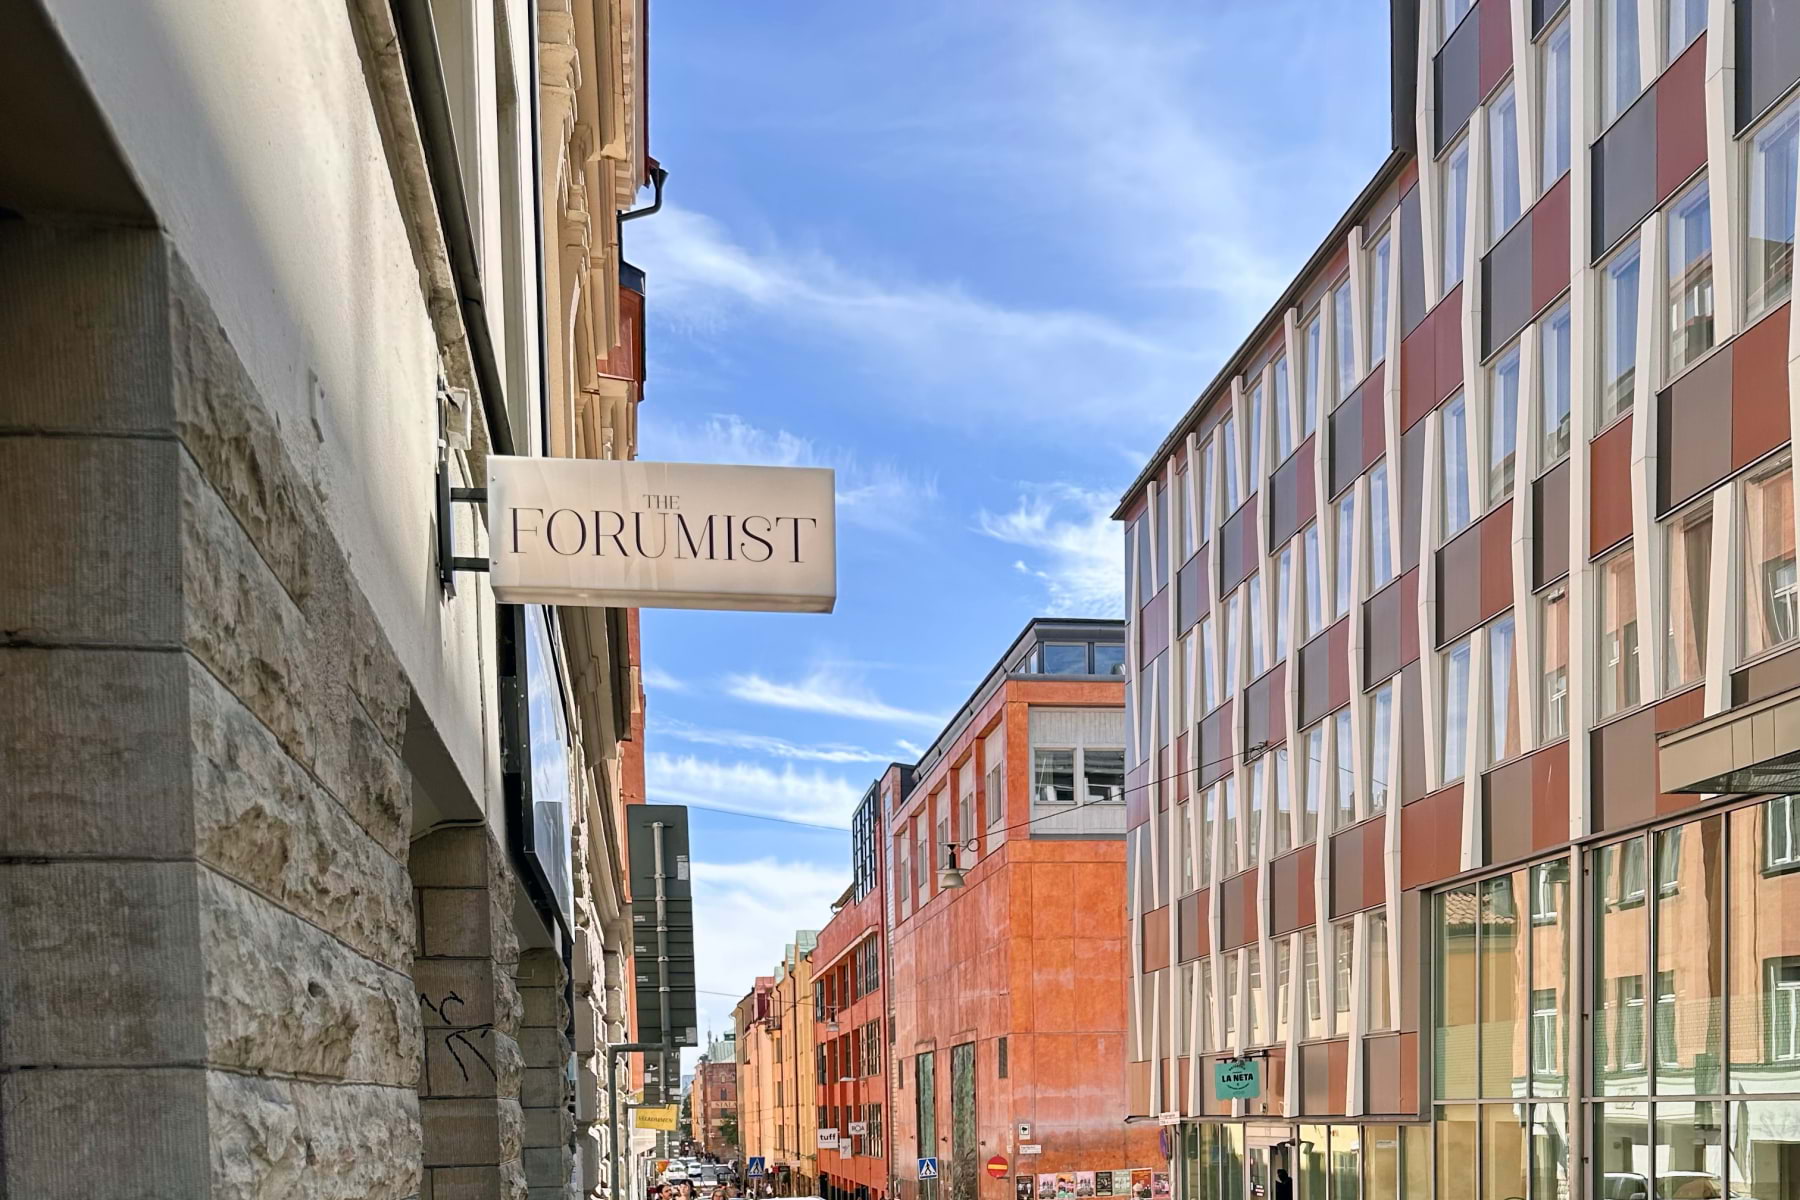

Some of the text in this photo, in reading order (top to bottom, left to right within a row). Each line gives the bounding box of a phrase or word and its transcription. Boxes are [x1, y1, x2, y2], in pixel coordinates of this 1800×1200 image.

[642, 494, 680, 510] THE
[509, 507, 817, 564] FORUMIST
[1221, 1073, 1254, 1083] LA NETA
[820, 1133, 836, 1141] tuff
